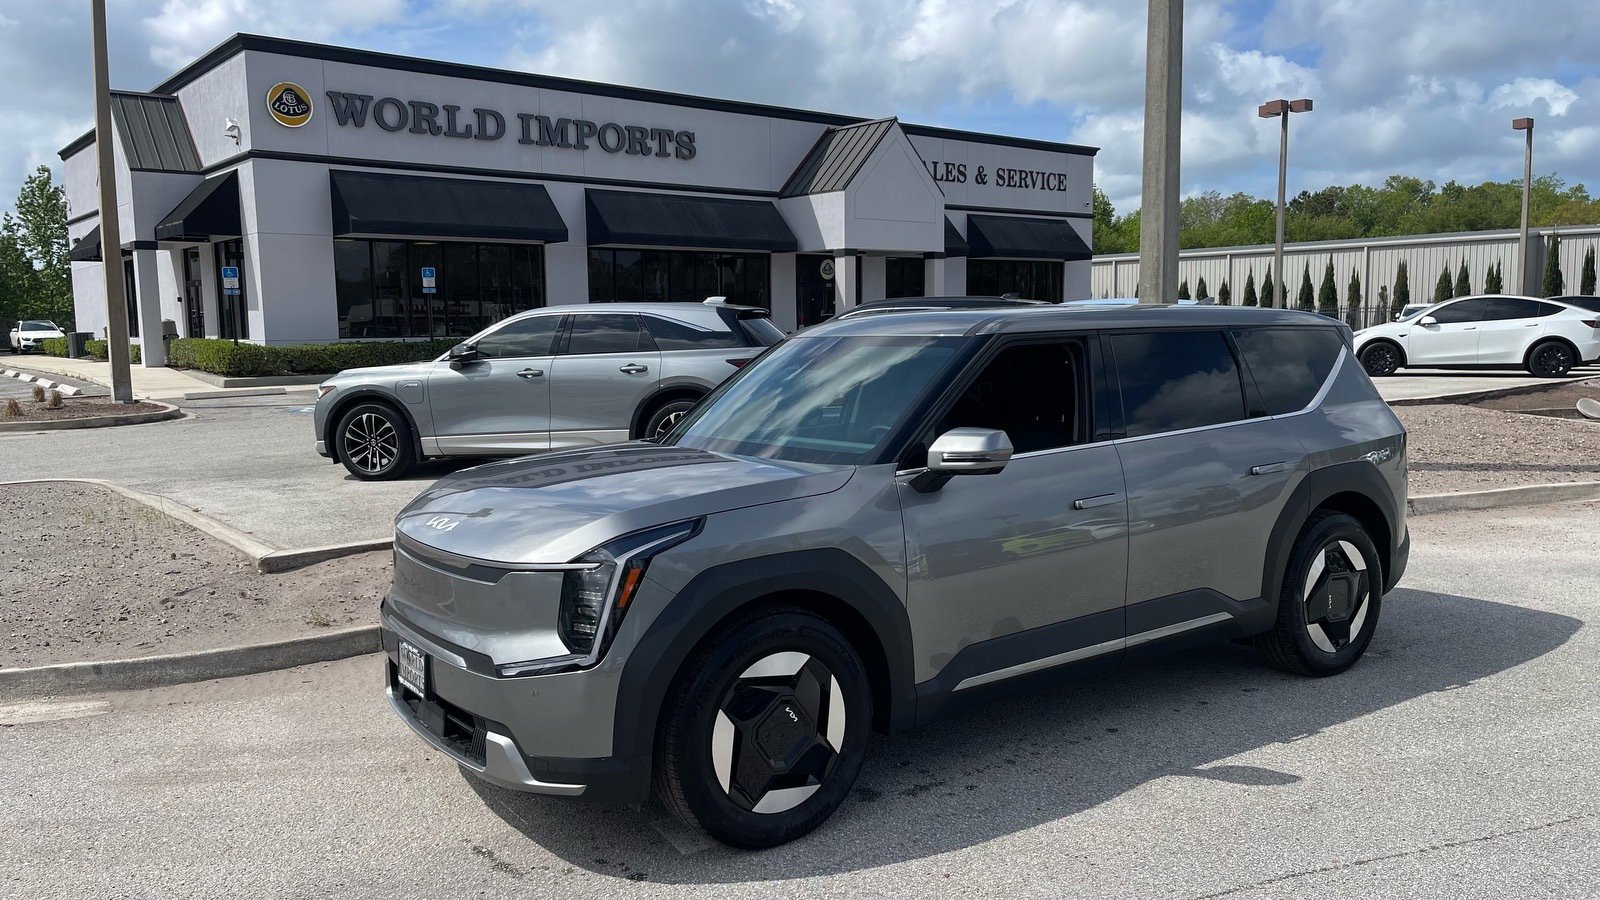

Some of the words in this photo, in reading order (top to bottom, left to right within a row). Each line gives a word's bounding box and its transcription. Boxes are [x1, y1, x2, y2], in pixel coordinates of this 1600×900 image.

[273, 101, 308, 114] LOTUS
[326, 90, 507, 141] WORLD
[517, 112, 697, 161] IMPORTS
[923, 160, 967, 184] LES
[974, 165, 988, 186] &
[995, 167, 1067, 192] SERVICE
